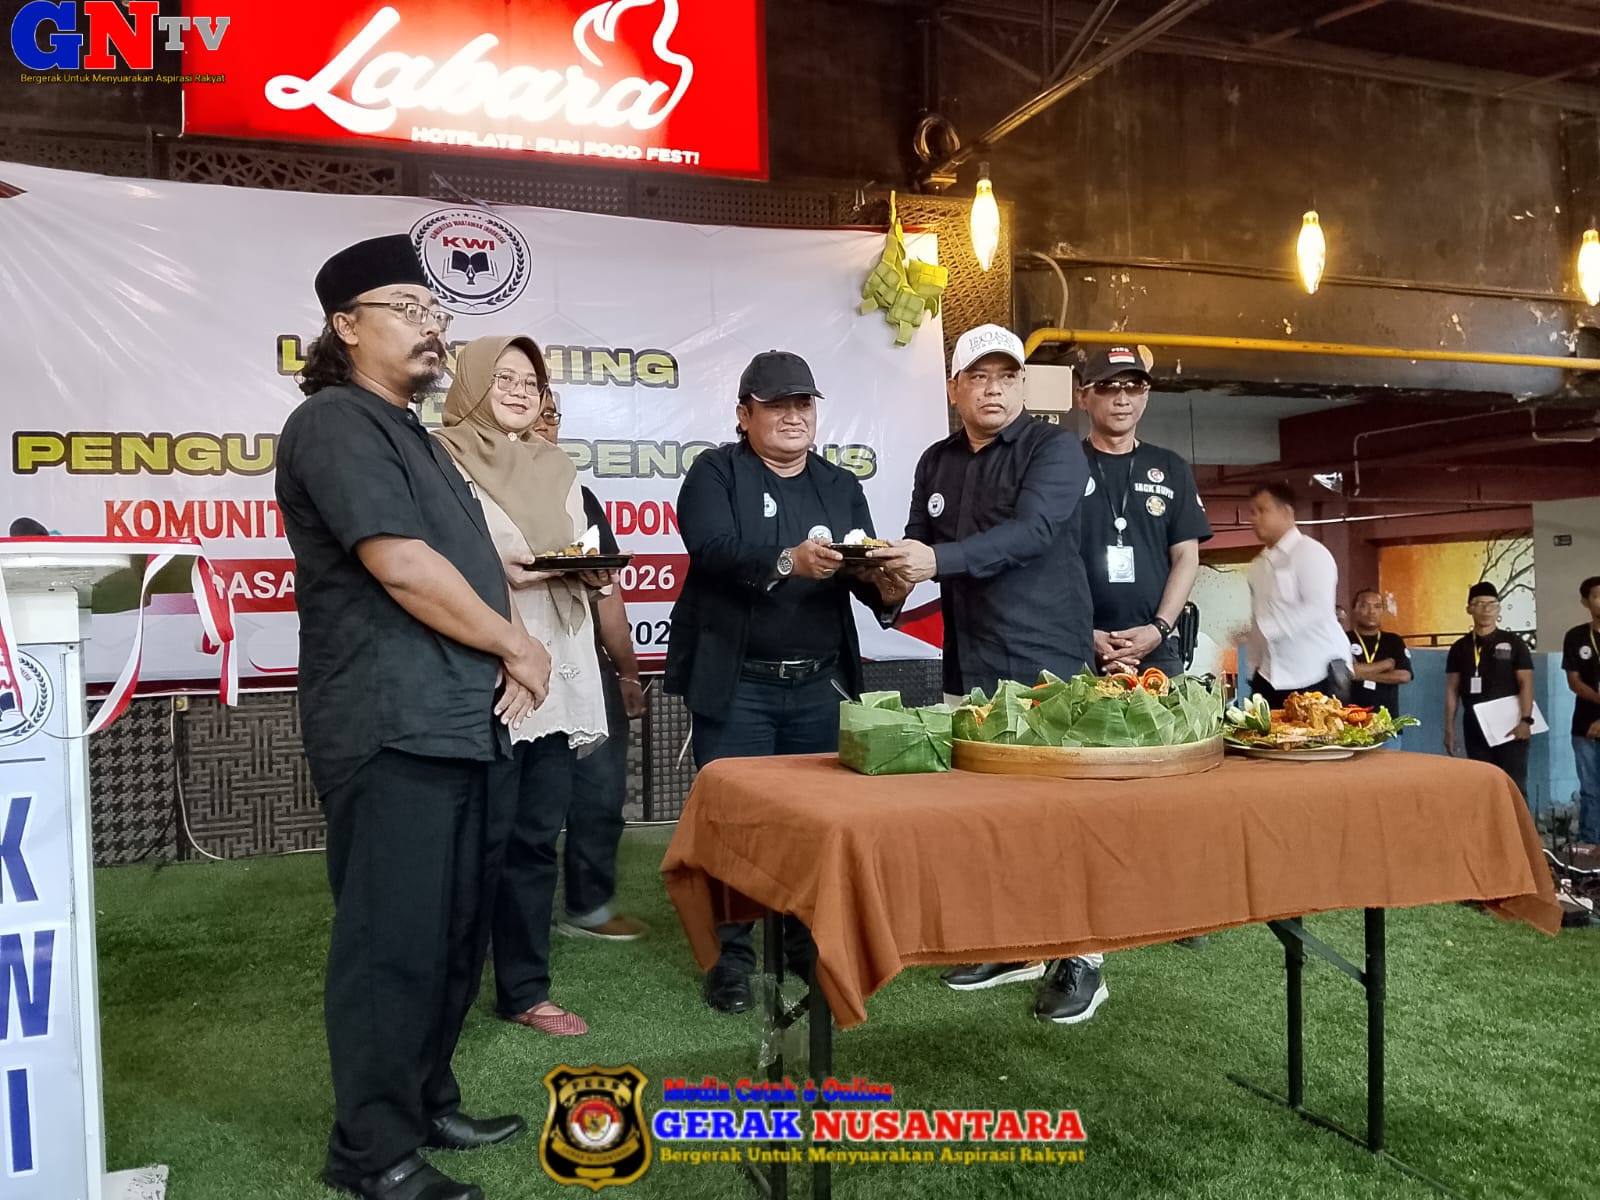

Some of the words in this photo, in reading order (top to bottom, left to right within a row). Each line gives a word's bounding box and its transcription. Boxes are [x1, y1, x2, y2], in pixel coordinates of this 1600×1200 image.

[646, 148, 700, 165] FEST!
[442, 236, 495, 251] KWI
[619, 564, 675, 590] 026
